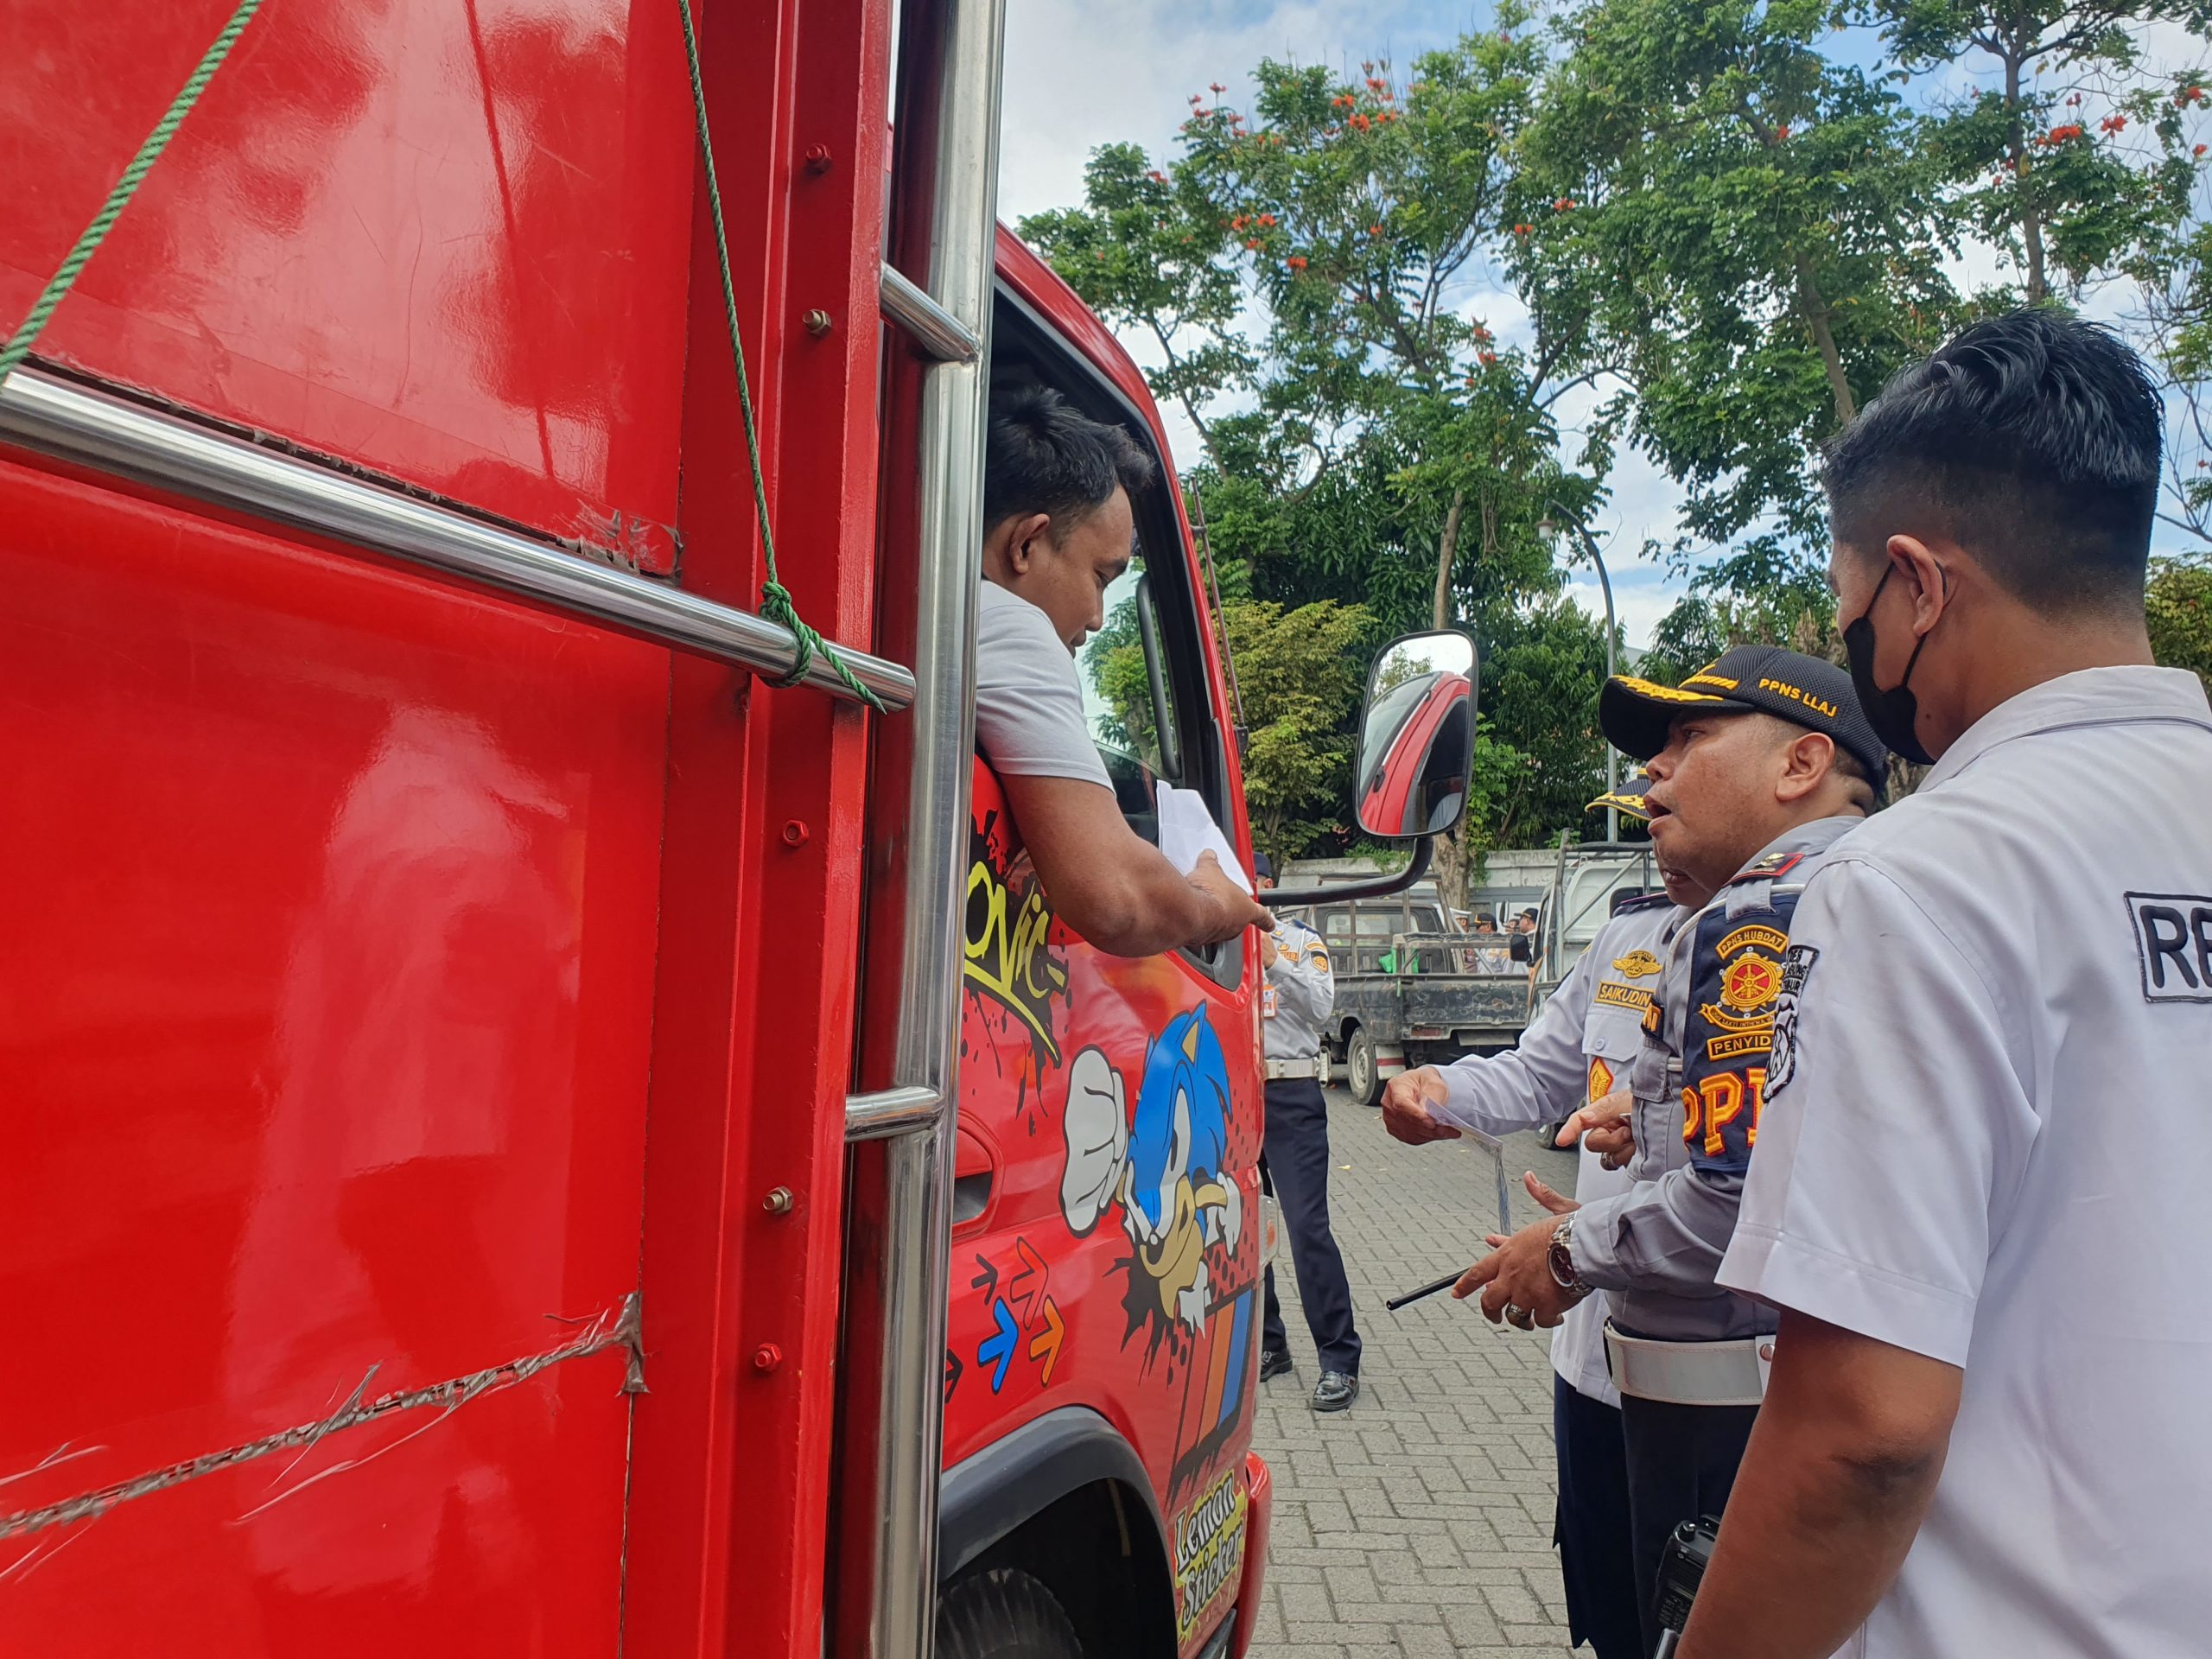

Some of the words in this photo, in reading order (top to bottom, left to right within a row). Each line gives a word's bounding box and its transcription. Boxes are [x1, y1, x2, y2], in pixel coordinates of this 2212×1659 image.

[1758, 678, 1801, 700] PPNS
[1802, 692, 1837, 717] LLAJ
[1721, 933, 1742, 950] PPNS
[1744, 931, 1783, 946] HUBDAT
[1600, 985, 1651, 1007] SAIKUDIN
[1176, 1472, 1236, 1576] Lemon
[1182, 1524, 1243, 1631] Sticker
